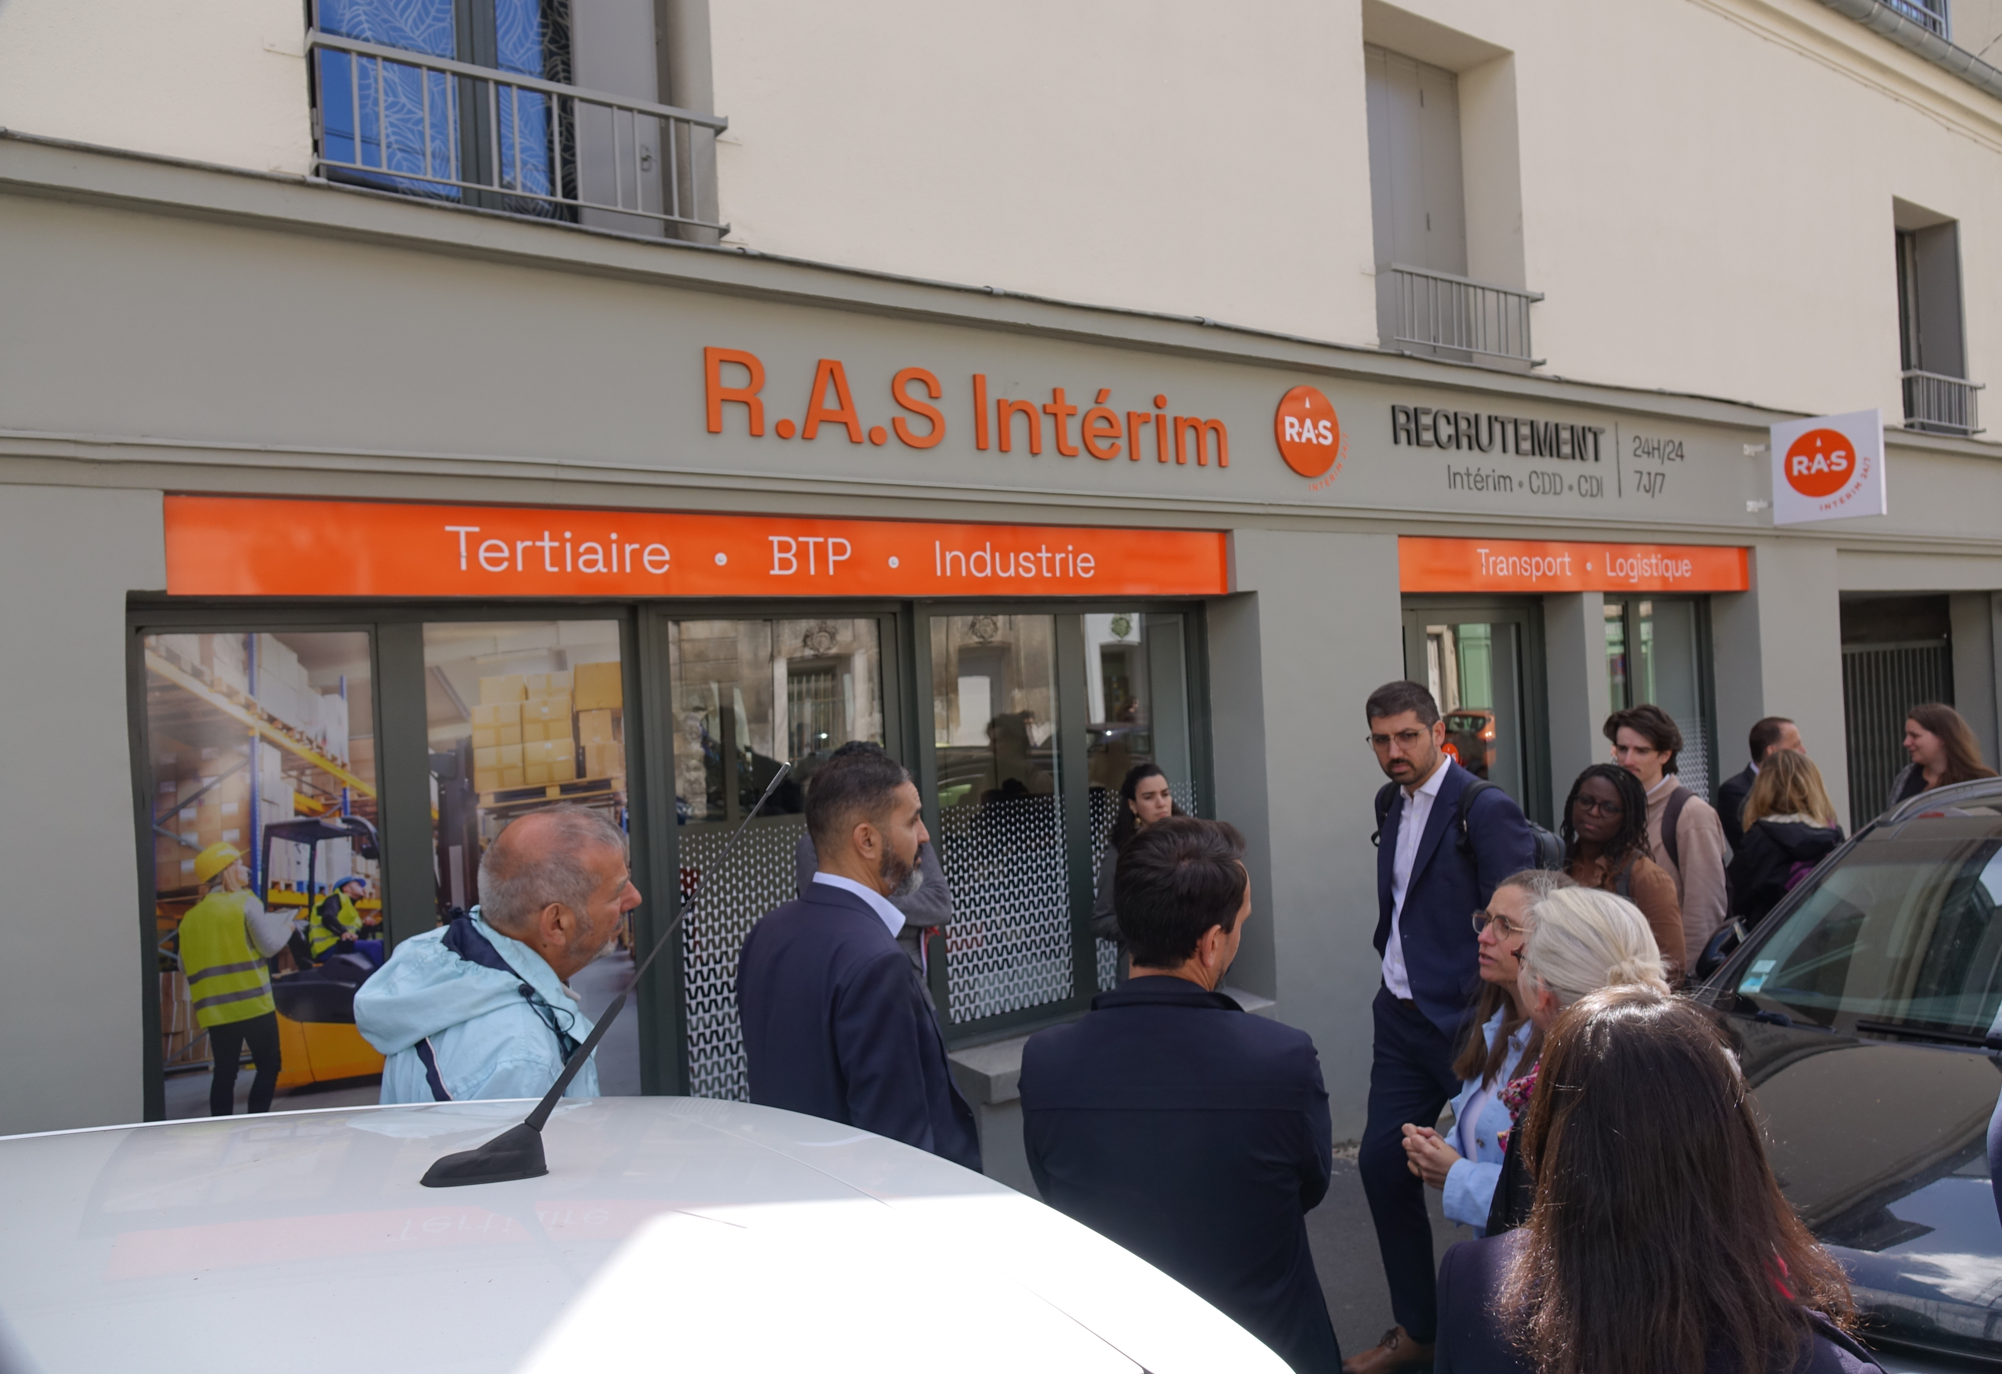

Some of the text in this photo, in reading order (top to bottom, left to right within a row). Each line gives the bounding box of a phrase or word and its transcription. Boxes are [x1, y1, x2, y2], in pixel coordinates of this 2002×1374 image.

[703, 345, 1229, 468] R.A.S Intérim
[1391, 403, 1605, 463] RECRUTEMENT
[1632, 434, 1685, 466] 24H/24
[1446, 464, 1604, 499] Intérim CDD CDI
[1633, 470, 1667, 499] 7J/7
[444, 525, 1096, 579] Tertiaire BTP Industrie
[1476, 548, 1693, 583] Transport Logistique
